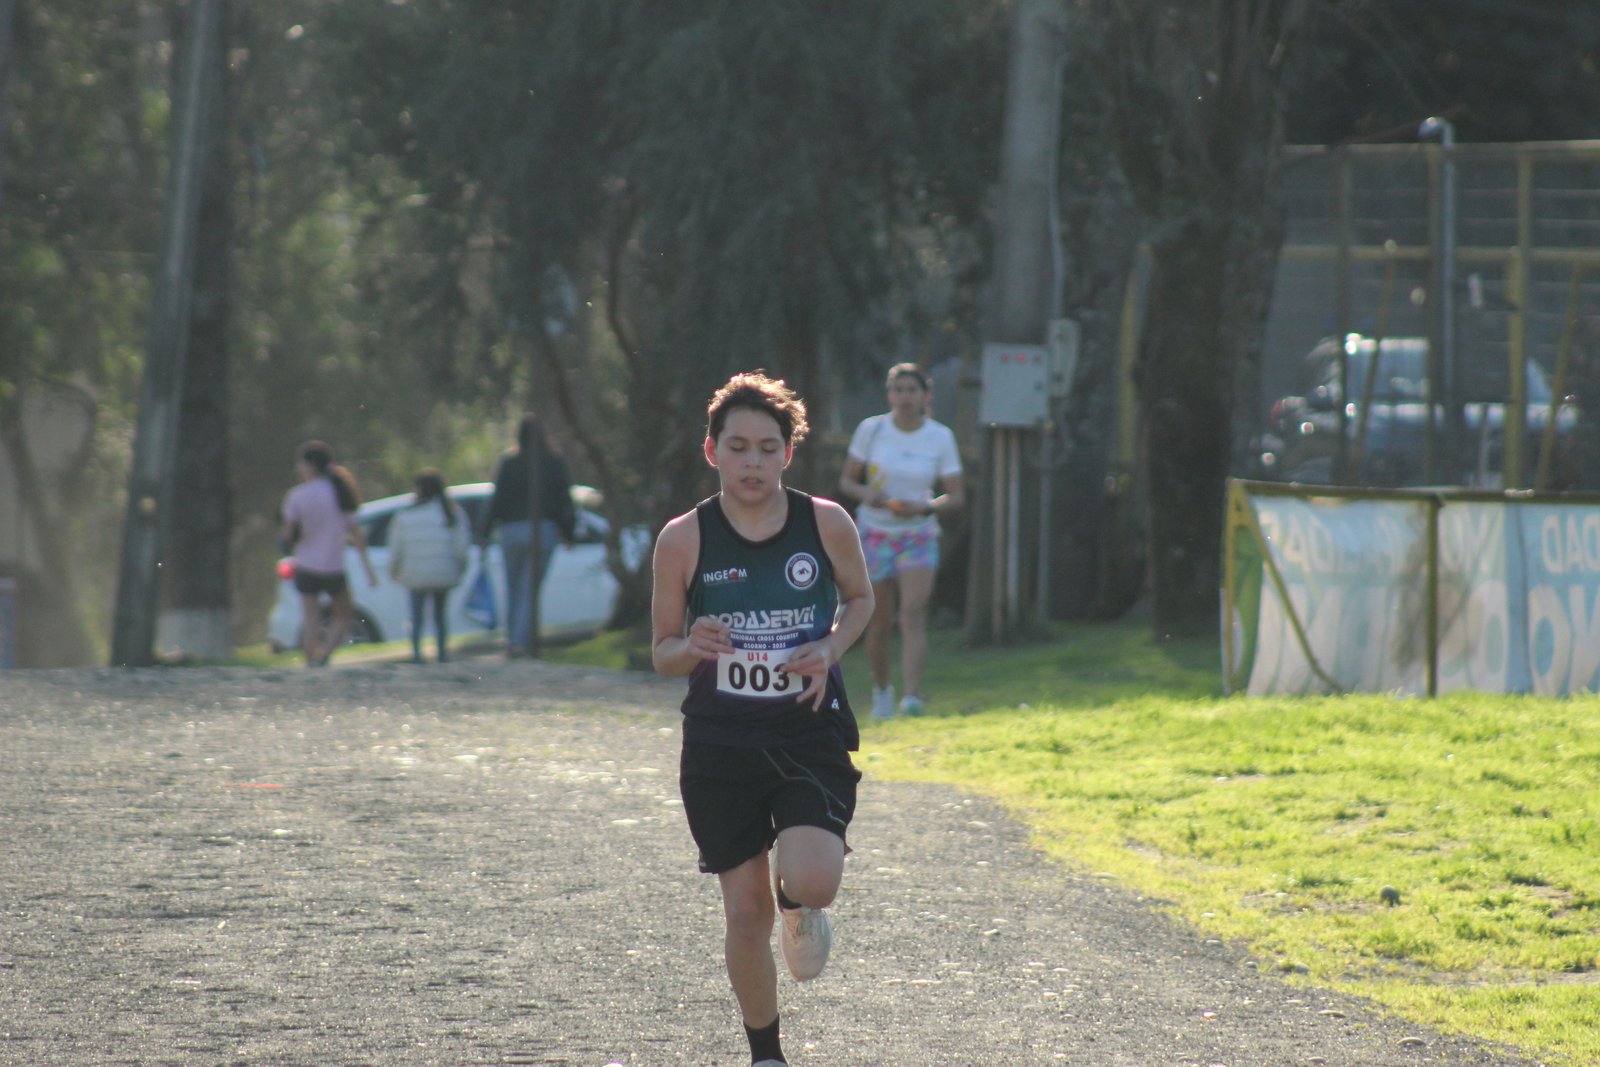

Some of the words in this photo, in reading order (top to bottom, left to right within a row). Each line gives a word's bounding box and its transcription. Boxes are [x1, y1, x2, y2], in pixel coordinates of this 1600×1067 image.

[730, 632, 756, 641] REGIONAL
[757, 634, 775, 642] CROSS
[776, 632, 799, 641] COUNTRY
[747, 652, 768, 662] U14
[728, 661, 790, 692] 003
